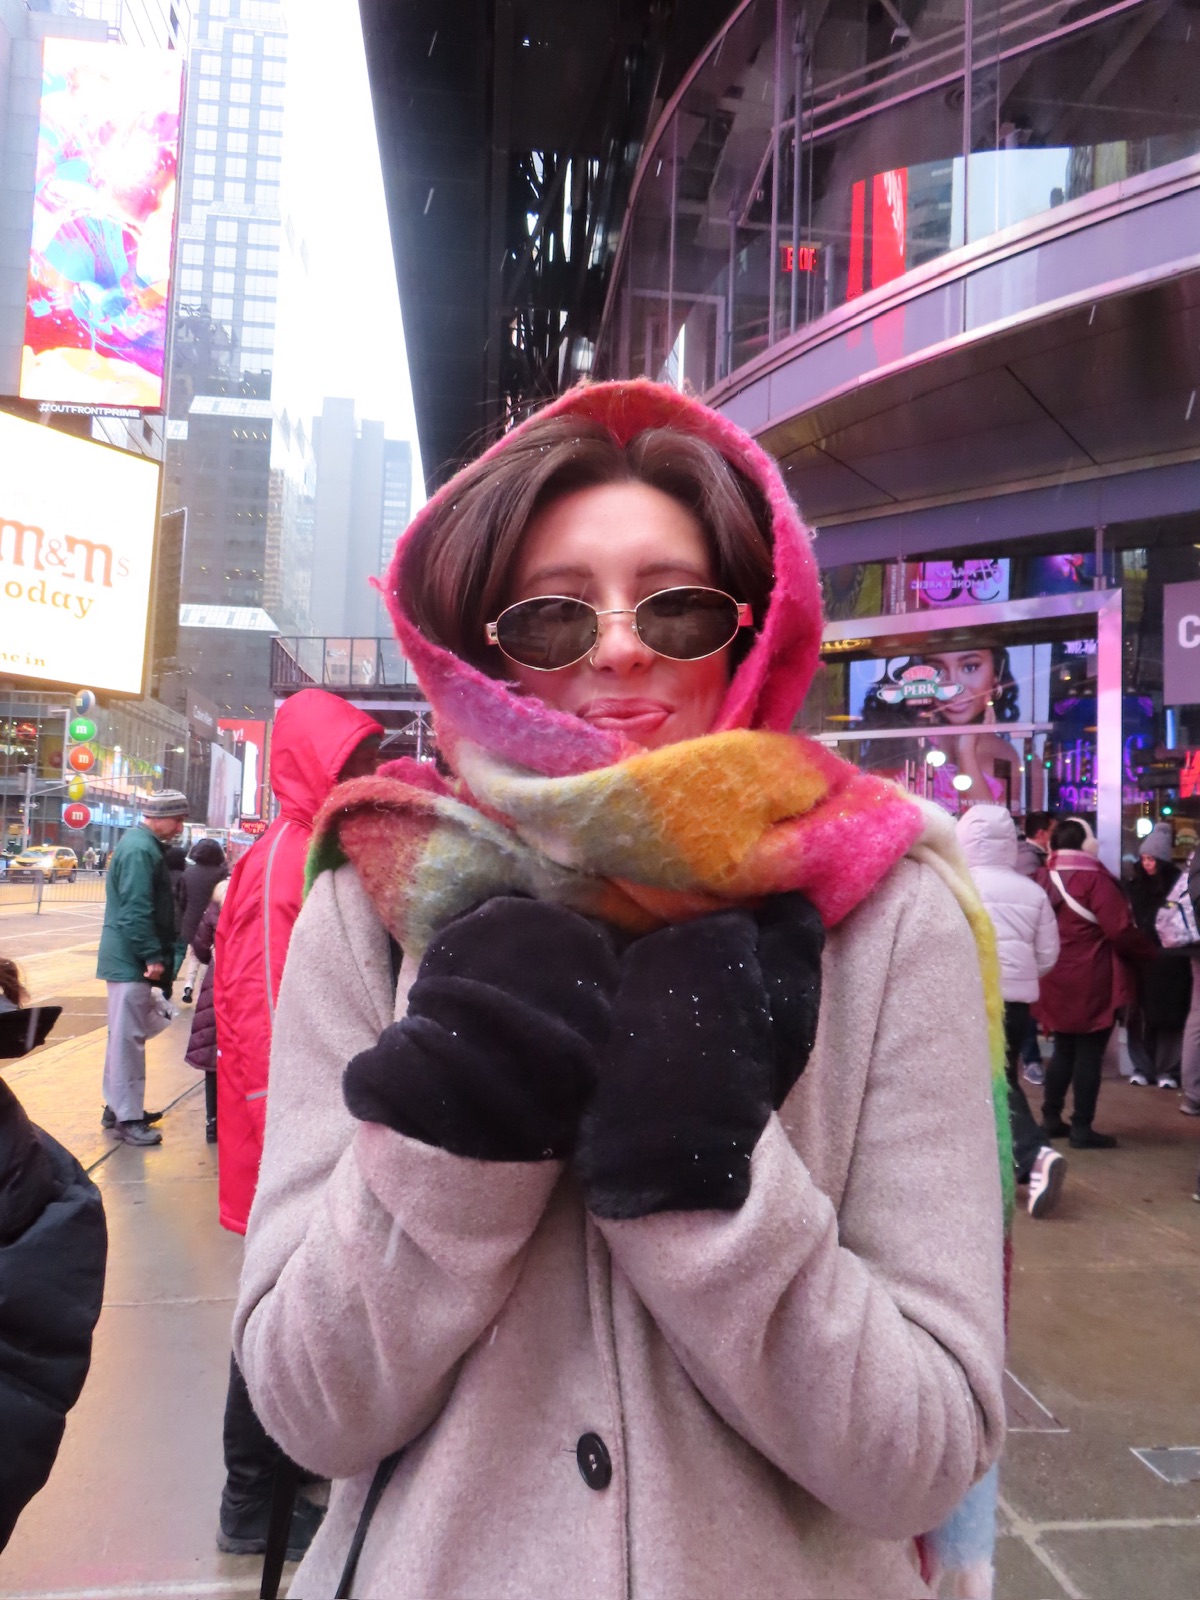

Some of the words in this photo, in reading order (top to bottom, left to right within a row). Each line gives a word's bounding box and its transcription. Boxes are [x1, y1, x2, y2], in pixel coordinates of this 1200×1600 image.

[38, 402, 140, 418] #OUTFRONTPRIME
[904, 683, 936, 696] PERK
[76, 725, 88, 734] m
[79, 754, 89, 763] m
[72, 811, 83, 820] m
